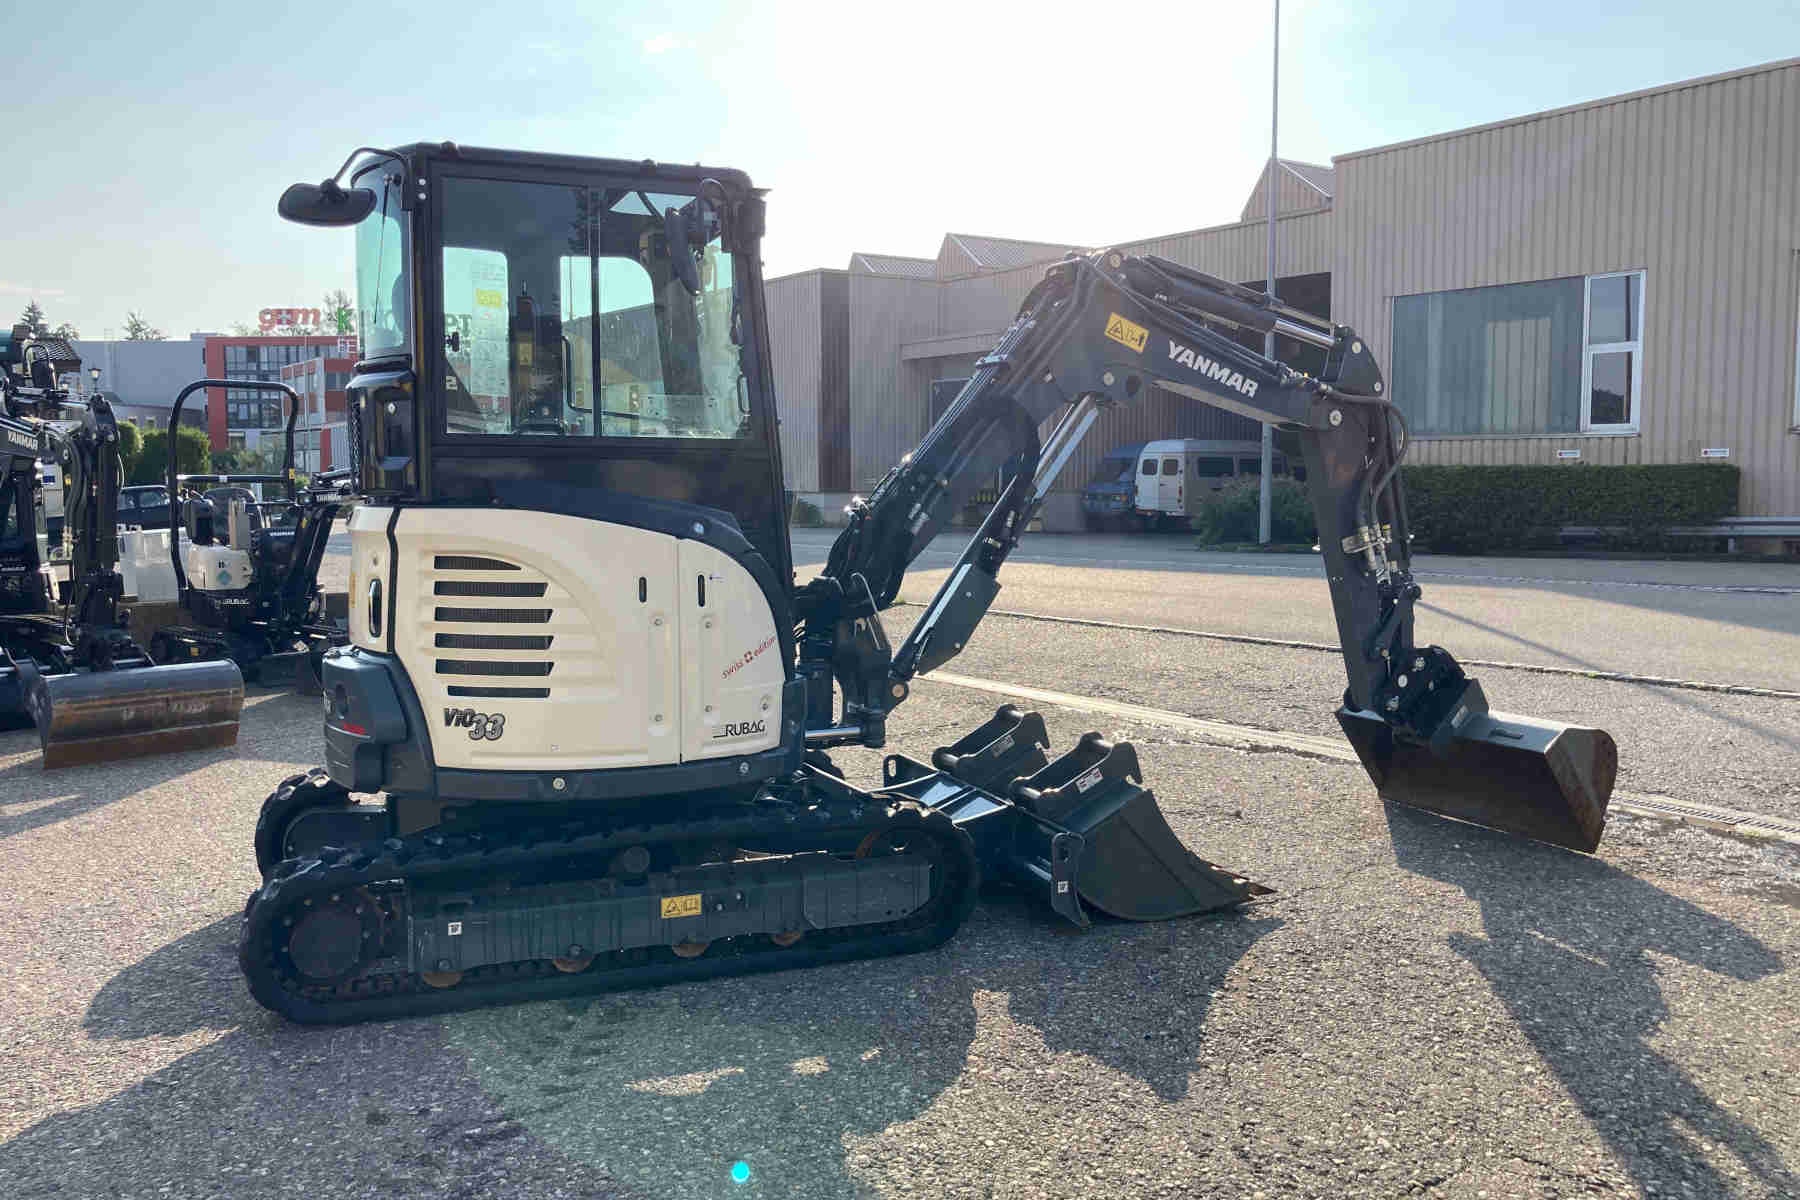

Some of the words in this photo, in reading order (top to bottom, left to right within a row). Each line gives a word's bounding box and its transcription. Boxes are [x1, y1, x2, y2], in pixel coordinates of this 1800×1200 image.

[1167, 340, 1259, 399] YANMAR
[721, 659, 744, 680] swiss
[725, 720, 766, 737] RUBAG
